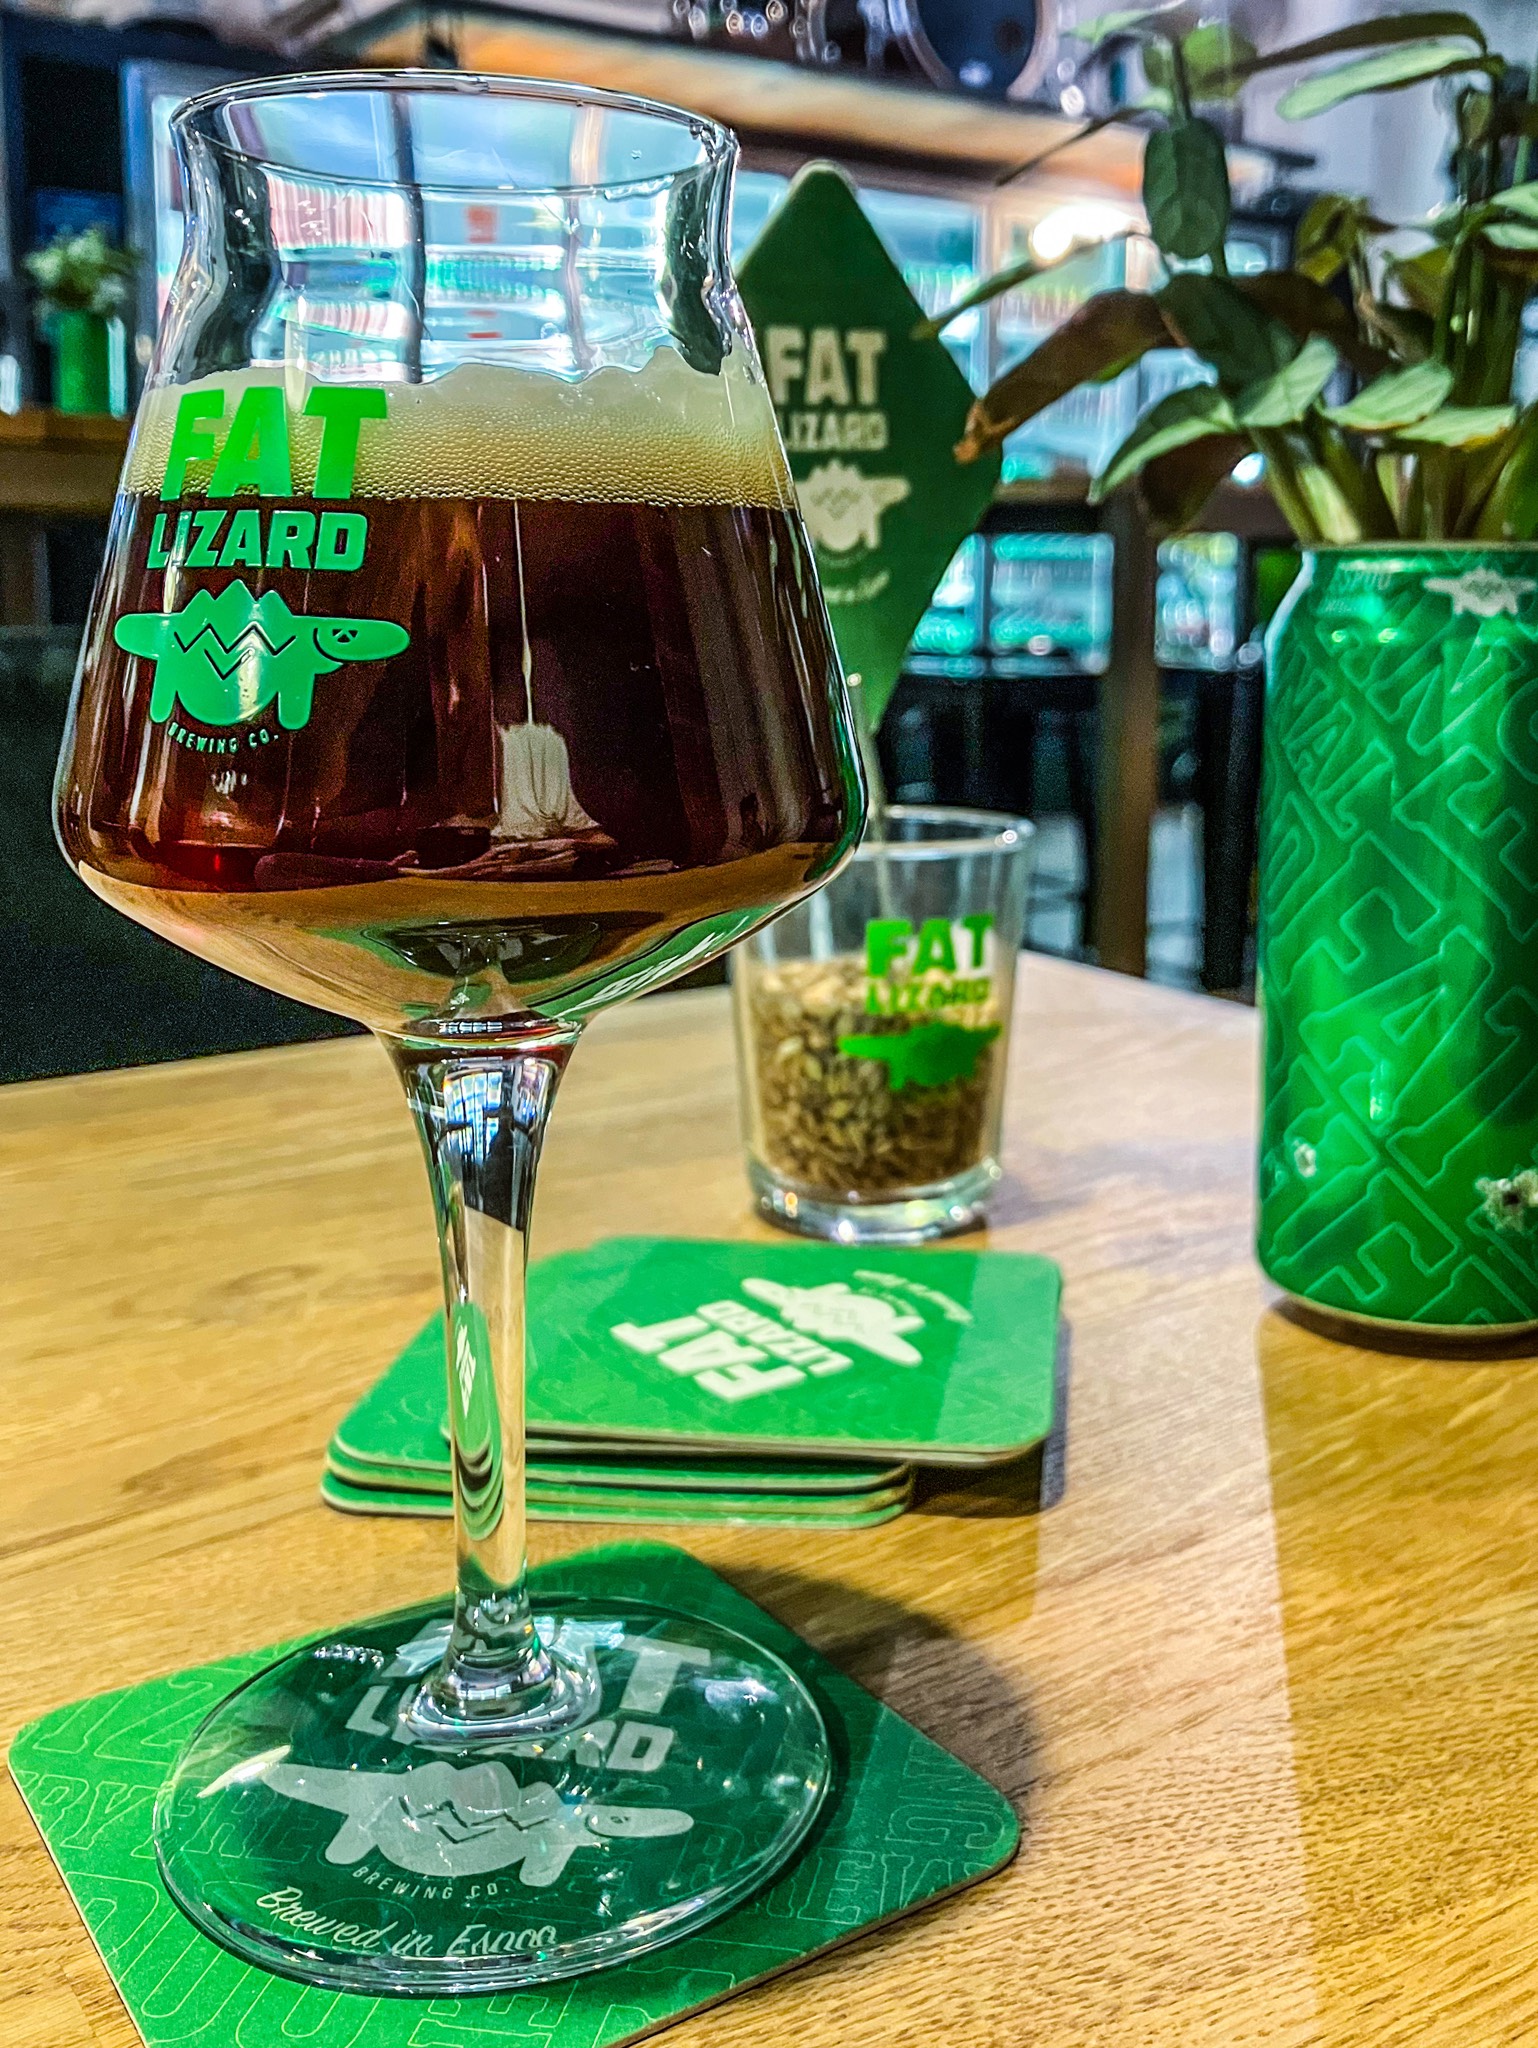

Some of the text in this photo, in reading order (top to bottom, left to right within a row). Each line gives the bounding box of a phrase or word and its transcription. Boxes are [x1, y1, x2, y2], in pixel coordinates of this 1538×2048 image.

[765, 325, 886, 405] FAT
[160, 386, 387, 501] FAT
[146, 509, 368, 571] LIZARD
[167, 722, 280, 754] BREWING CO.
[866, 912, 993, 977] FAT
[609, 1314, 807, 1402] FAT
[695, 1299, 853, 1377] LIZARD
[352, 1866, 453, 1900] BREWING
[256, 1886, 398, 1950] Brewed
[391, 1928, 434, 1957] in
